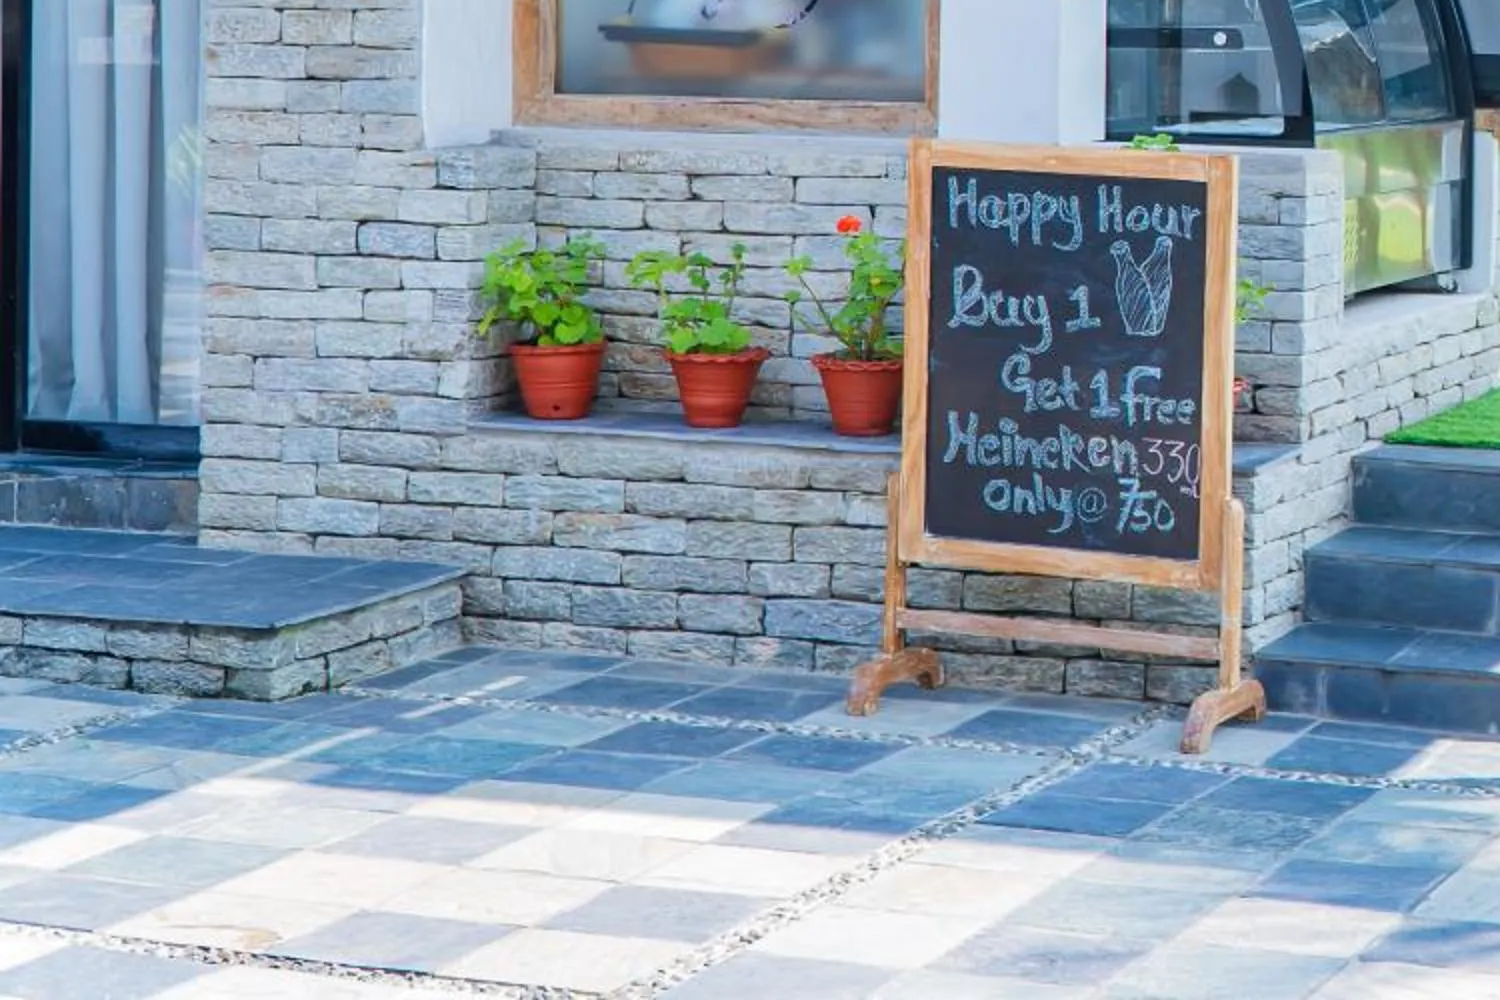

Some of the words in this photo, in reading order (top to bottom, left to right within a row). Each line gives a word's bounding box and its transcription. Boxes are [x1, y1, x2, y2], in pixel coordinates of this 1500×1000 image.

[947, 176, 1083, 251] Happy
[1098, 184, 1201, 240] Hour
[947, 264, 1053, 355] Buy
[1064, 285, 1102, 333] 1
[1001, 353, 1082, 413] Get
[1089, 370, 1120, 420] 1
[943, 410, 1139, 474] Heineken
[1141, 437, 1201, 483] 330
[1116, 478, 1175, 534] 750
